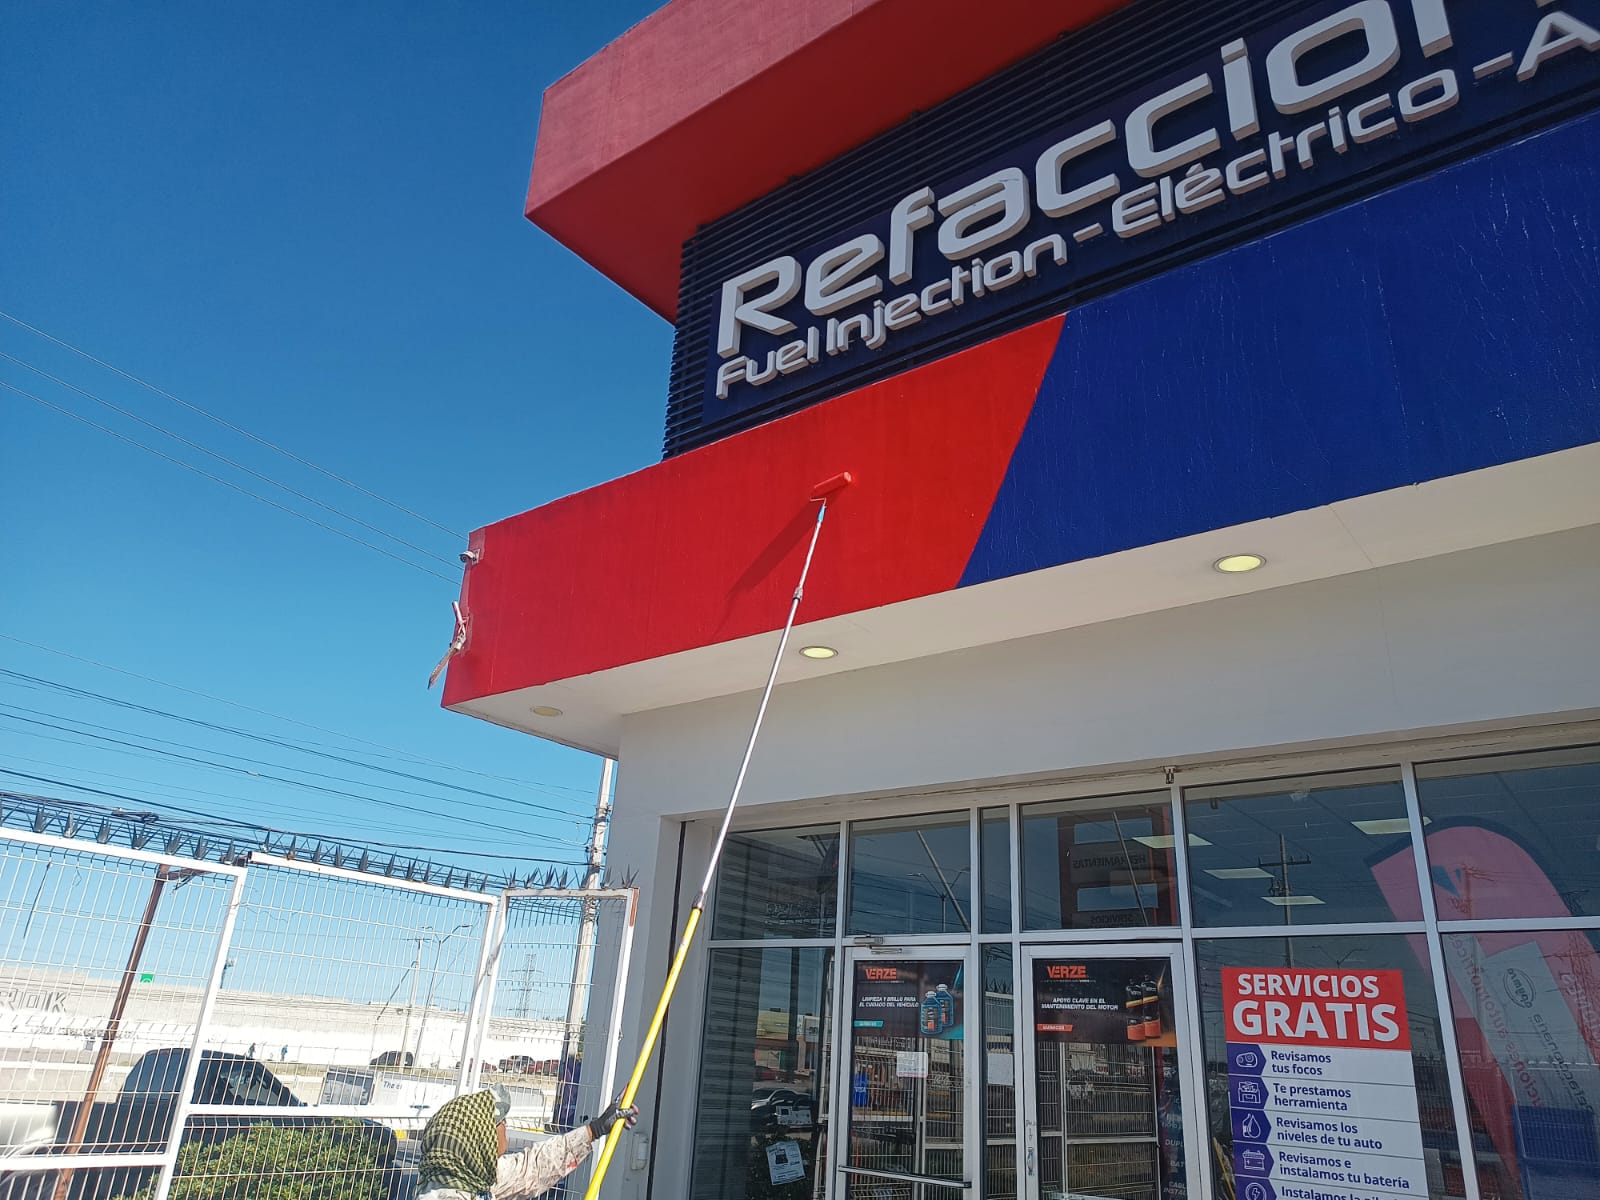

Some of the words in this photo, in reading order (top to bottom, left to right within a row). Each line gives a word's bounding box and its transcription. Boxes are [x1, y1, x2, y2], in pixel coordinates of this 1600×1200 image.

[715, 326, 819, 400] Fuel
[826, 233, 1067, 356] Injection
[1111, 69, 1459, 239] Eléctrico
[865, 968, 897, 980] VERZE
[1047, 965, 1088, 979] VERZE
[1237, 973, 1379, 998] SERVICIOS
[1232, 1000, 1400, 1042] GRATIS
[1271, 1051, 1331, 1063] Revisamos
[1272, 1064, 1289, 1074] tus
[1292, 1063, 1323, 1076] focos
[1273, 1083, 1286, 1094] Te
[1289, 1084, 1351, 1098] prestamos
[1274, 1096, 1348, 1111] herramienta
[1276, 1117, 1338, 1132] Revisamos
[1341, 1121, 1358, 1134] los
[1277, 1131, 1317, 1145] niveles
[1320, 1133, 1335, 1146] de
[1338, 1137, 1351, 1147] tu
[1354, 1138, 1382, 1150] auto
[1279, 1151, 1340, 1168] Revisamos
[1344, 1160, 1352, 1168] e
[1279, 1164, 1344, 1182] instalamos
[1348, 1172, 1361, 1183] tu
